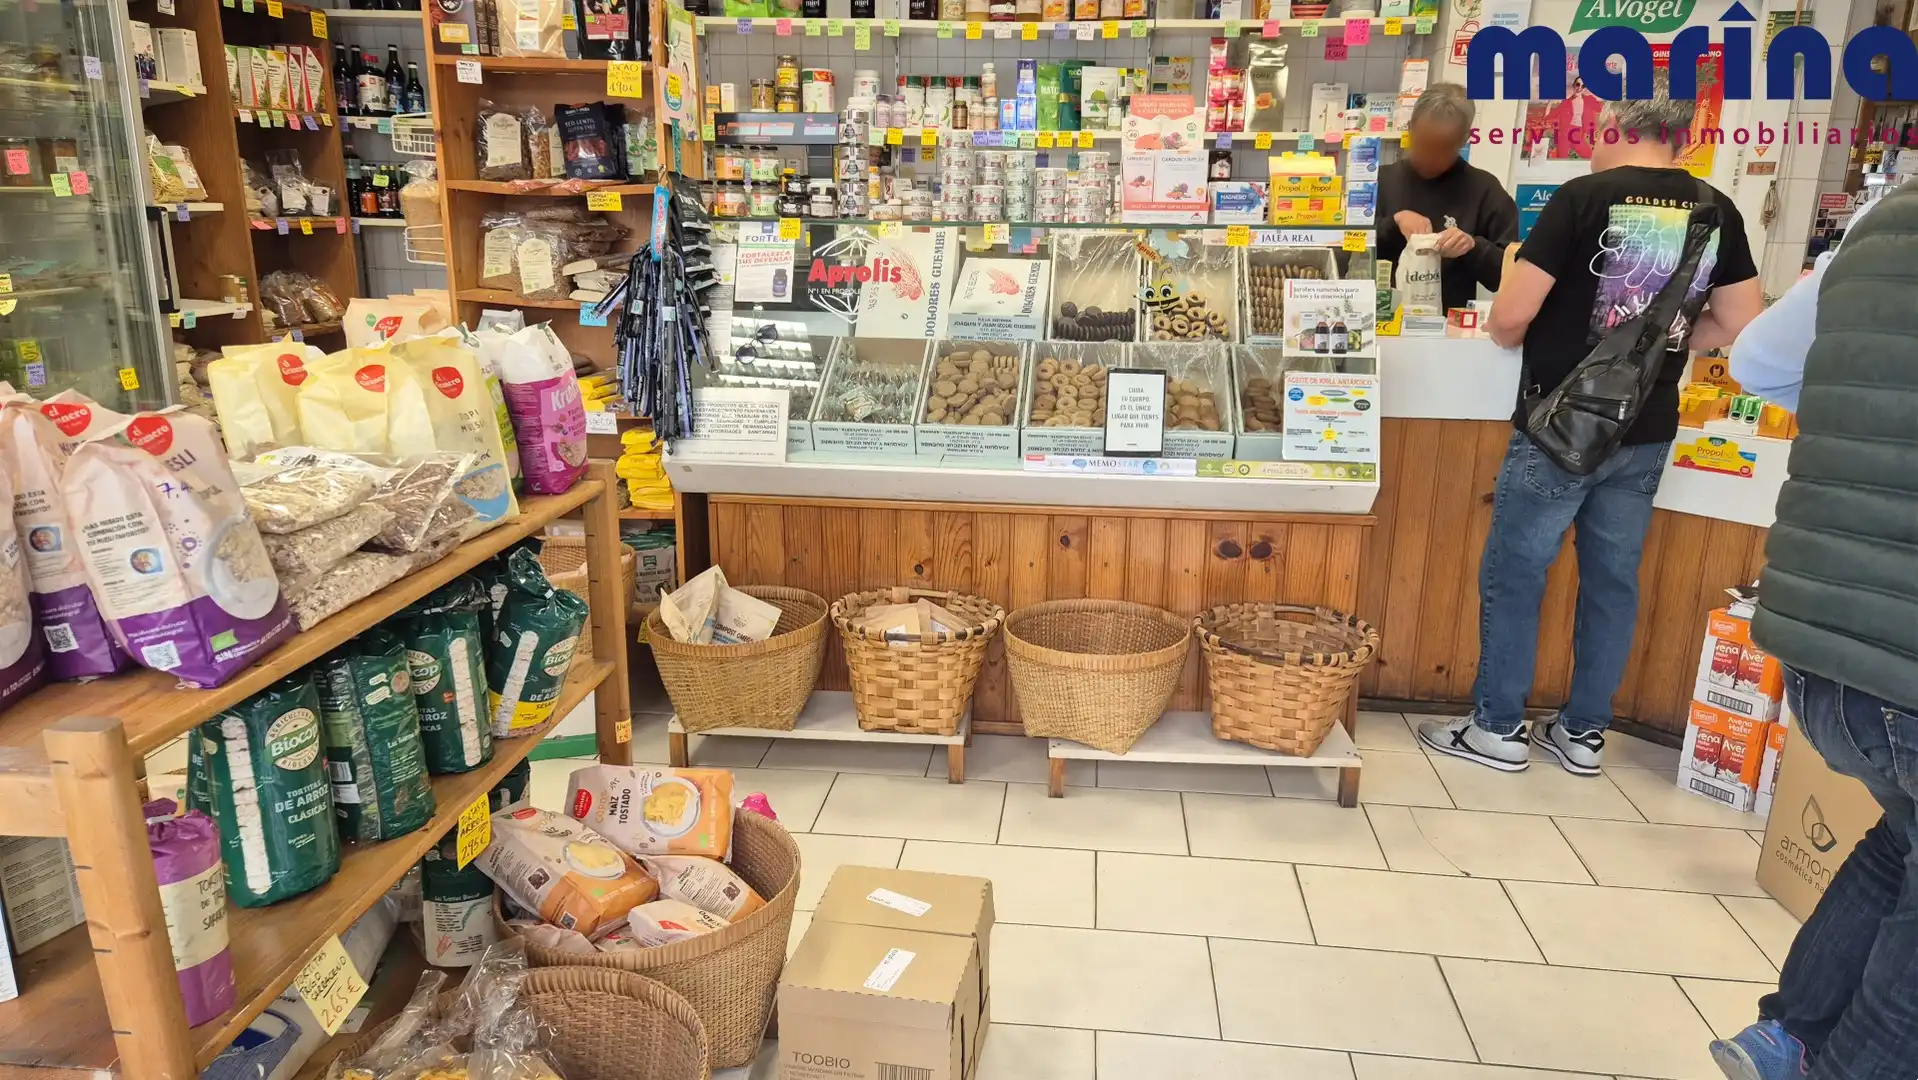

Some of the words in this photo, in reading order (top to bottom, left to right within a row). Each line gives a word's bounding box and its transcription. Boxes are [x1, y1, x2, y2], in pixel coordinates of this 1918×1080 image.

[1624, 195, 1677, 207] GOLDEN
[1261, 232, 1289, 243] JALEA
[1292, 233, 1315, 243] REAL
[807, 257, 902, 288] Aprolis
[924, 282, 941, 337] DOLORES
[270, 722, 319, 758] Biocop
[274, 799, 295, 813] DE
[296, 783, 329, 808] ARROZ
[285, 779, 323, 799] TORTITAS
[287, 801, 328, 825] CLÁSICAS
[618, 788, 632, 825] TOSTADO
[792, 1051, 851, 1069] TOOBIO
